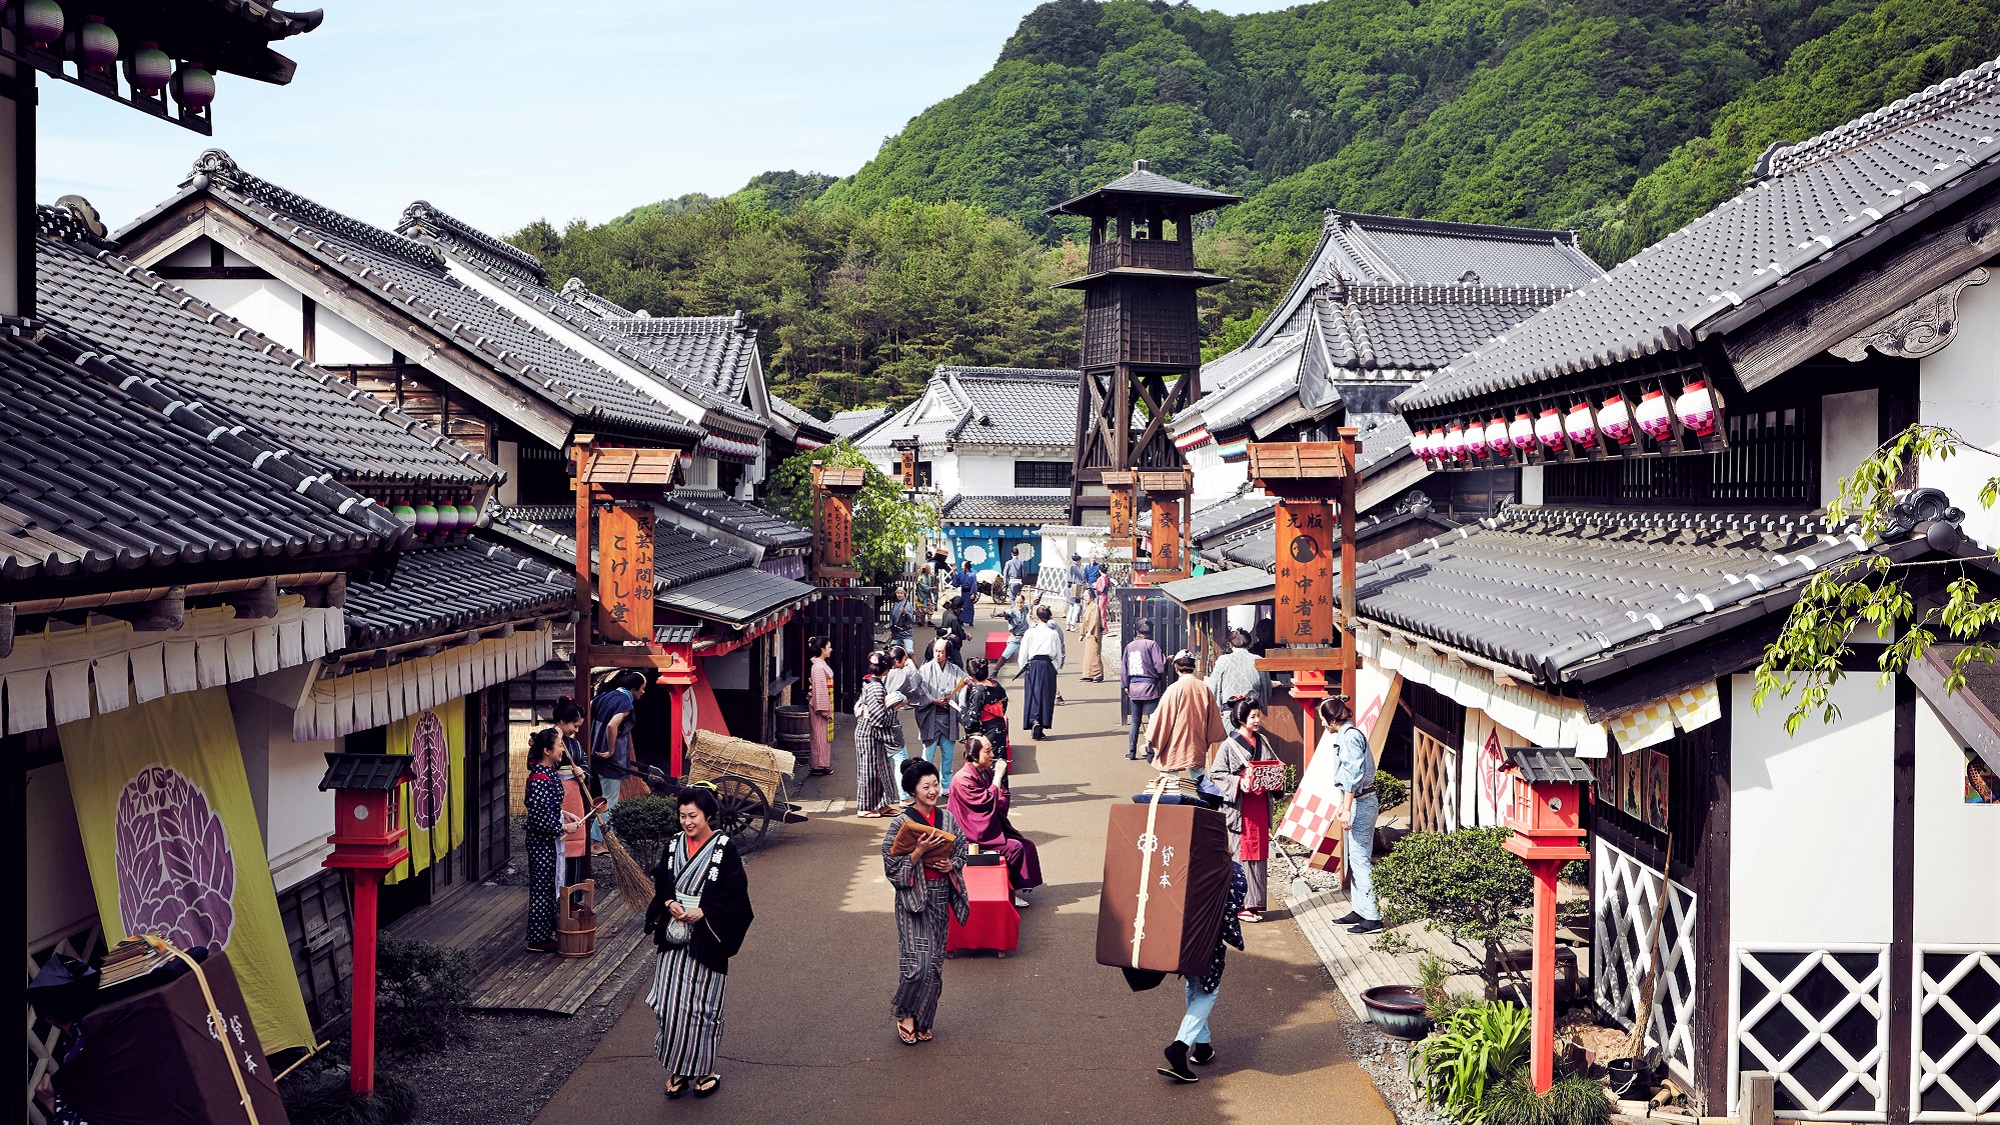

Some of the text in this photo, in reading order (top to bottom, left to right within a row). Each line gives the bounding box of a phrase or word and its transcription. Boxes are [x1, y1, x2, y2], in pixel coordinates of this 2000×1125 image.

[609, 534, 630, 624] こけし堂
[634, 516, 652, 601] 民芸小間物
[1158, 845, 1175, 889] 貸本
